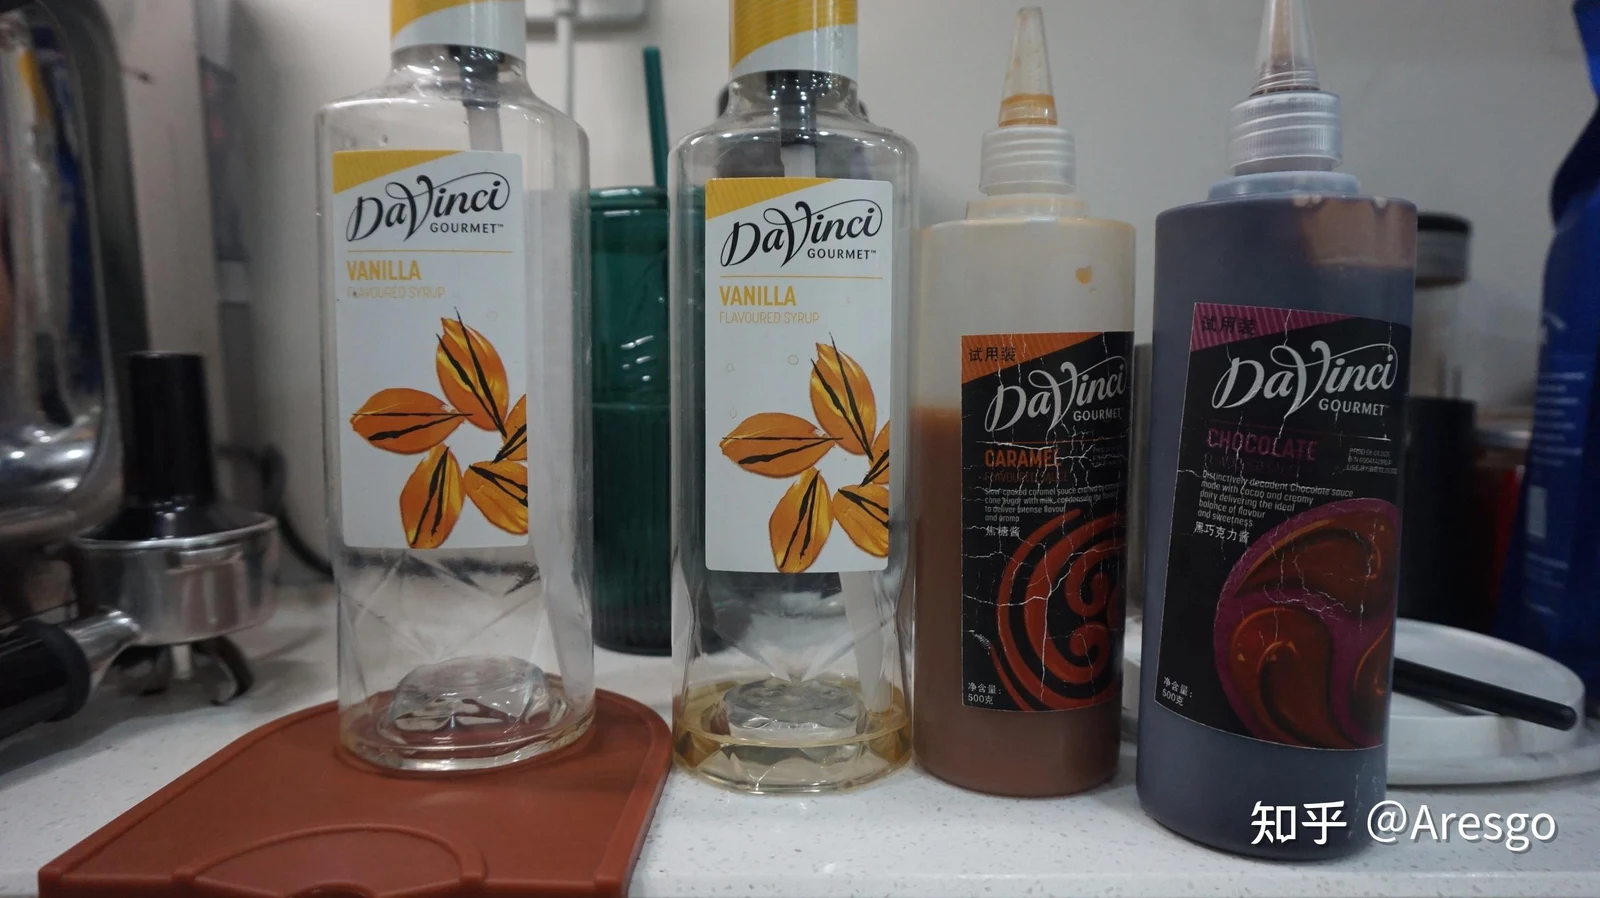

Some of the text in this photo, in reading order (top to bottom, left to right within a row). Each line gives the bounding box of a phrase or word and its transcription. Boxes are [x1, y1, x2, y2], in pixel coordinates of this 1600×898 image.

[345, 171, 510, 242] DaVinci
[720, 199, 883, 268] DaVinci
[346, 260, 422, 281] VANILLA
[408, 286, 446, 299] SYRUP
[719, 285, 797, 306] VANILLA
[719, 311, 820, 324] FLAVOURED SYRUP
[1200, 316, 1257, 337] 试用装
[968, 346, 1016, 362] 试用装
[1211, 340, 1398, 419] DaVinci
[984, 355, 1128, 433] DaVinci
[1207, 428, 1319, 461] CHOCOLATE
[984, 449, 1062, 467] CARAMEL
[1201, 479, 1314, 506] made with cacao and creamy
[1202, 469, 1354, 498] Distinctively decadent Chocolate sauce
[1198, 498, 1266, 519] balance of flavour
[1200, 489, 1296, 512] dairy delivering the ideal
[984, 514, 998, 522] and
[1197, 508, 1253, 527] and sweetness
[1193, 521, 1250, 545] 黑巧克力酱
[967, 693, 994, 705] 500克
[1161, 688, 1185, 707] 500克
